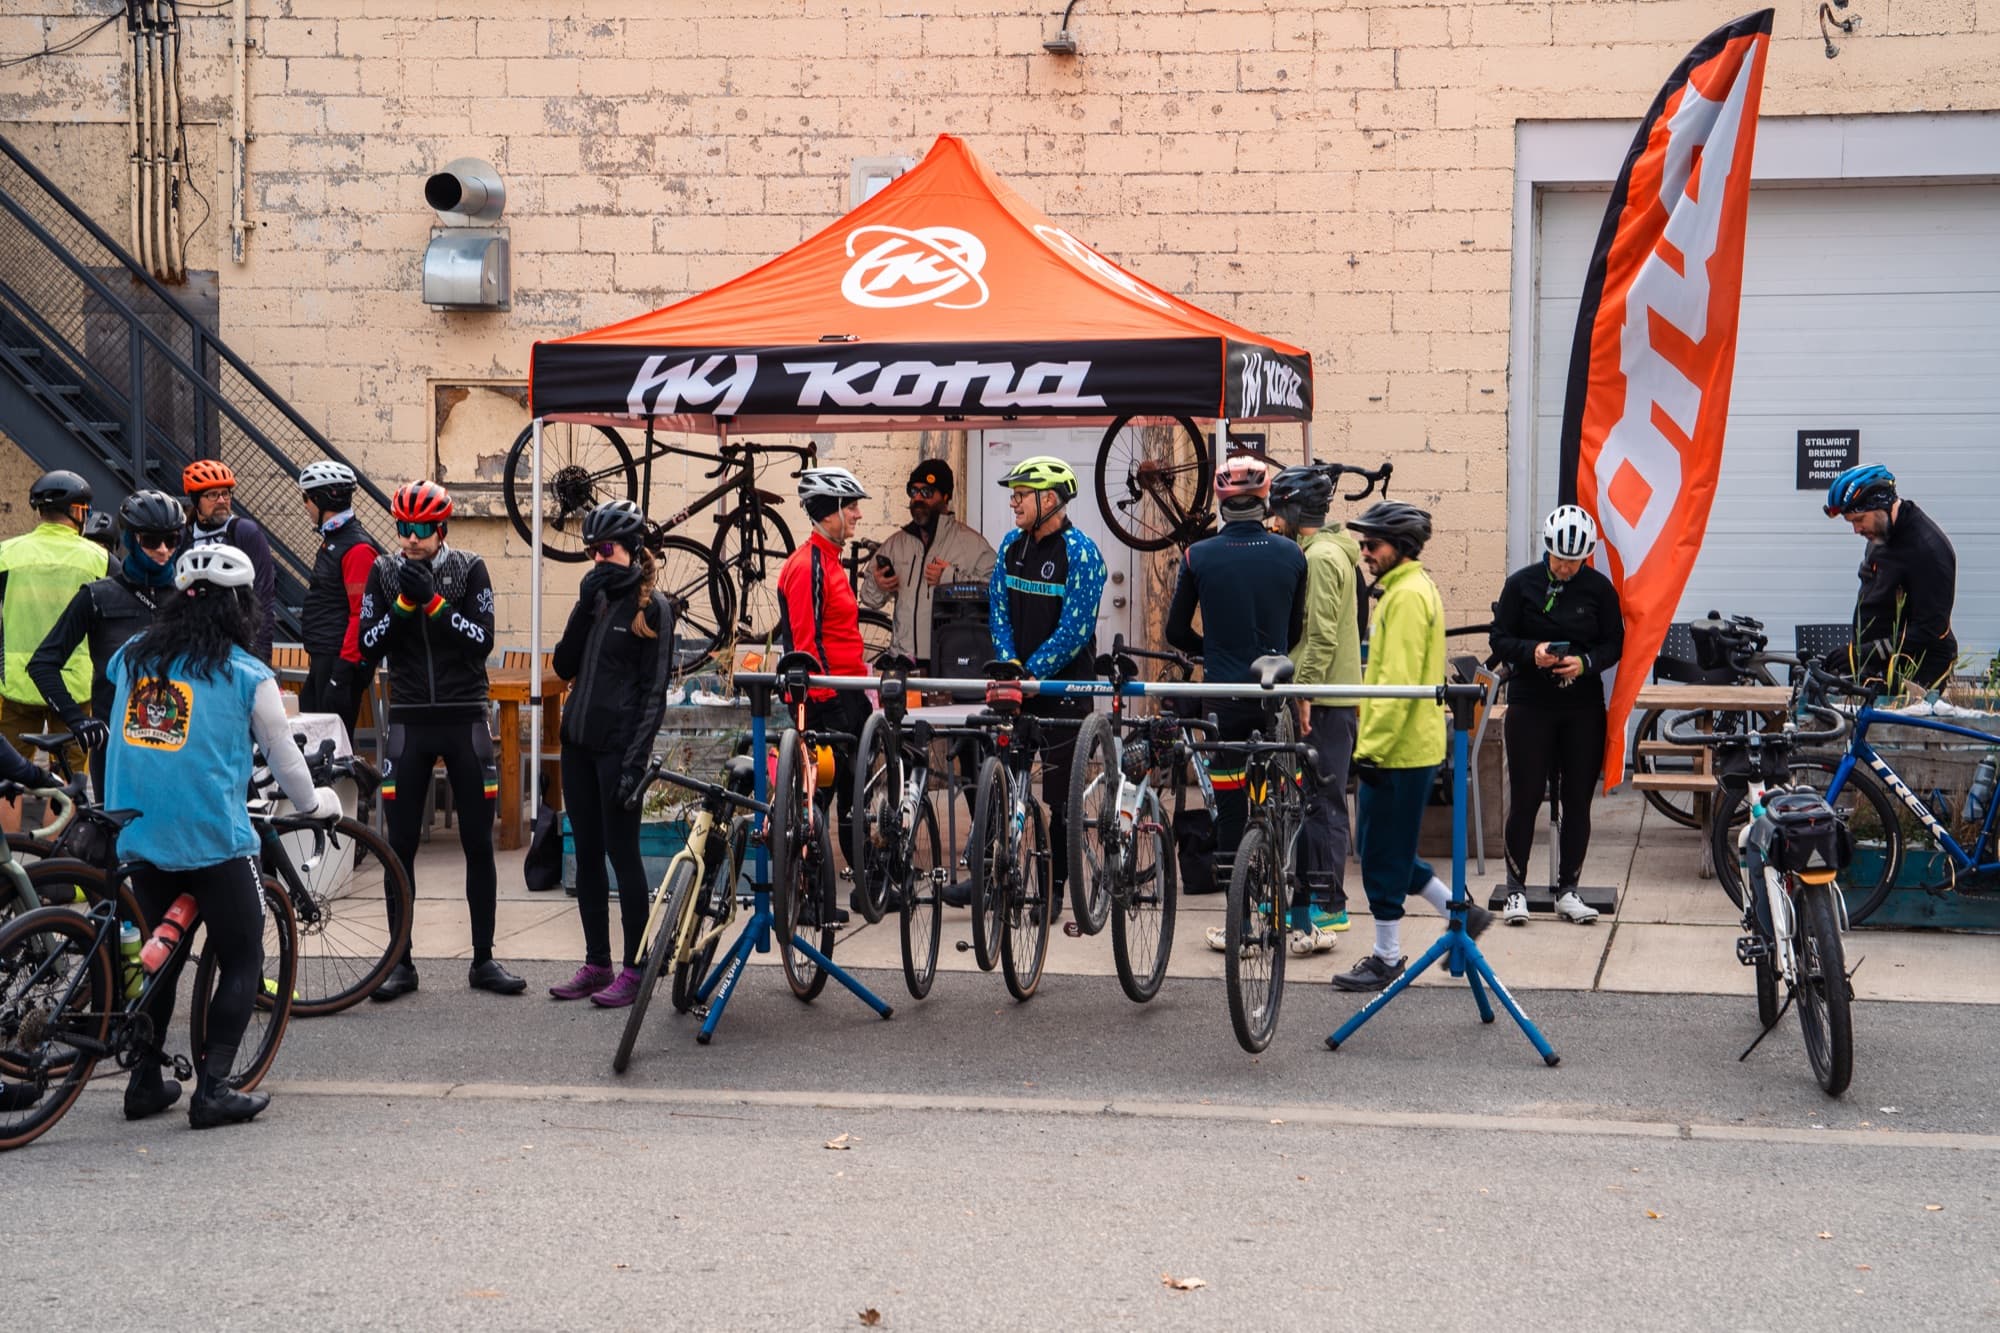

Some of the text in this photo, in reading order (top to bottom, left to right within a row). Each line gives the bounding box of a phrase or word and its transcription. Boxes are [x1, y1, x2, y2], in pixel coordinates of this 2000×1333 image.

[1805, 438, 1851, 446] STALWART
[1808, 449, 1847, 457] BREWING
[1813, 460, 1842, 468] GUEST
[1809, 471, 1845, 479] PARKIN
[363, 613, 391, 648] CPSS
[451, 612, 485, 643] CPSS
[1870, 751, 1949, 840] TREK
